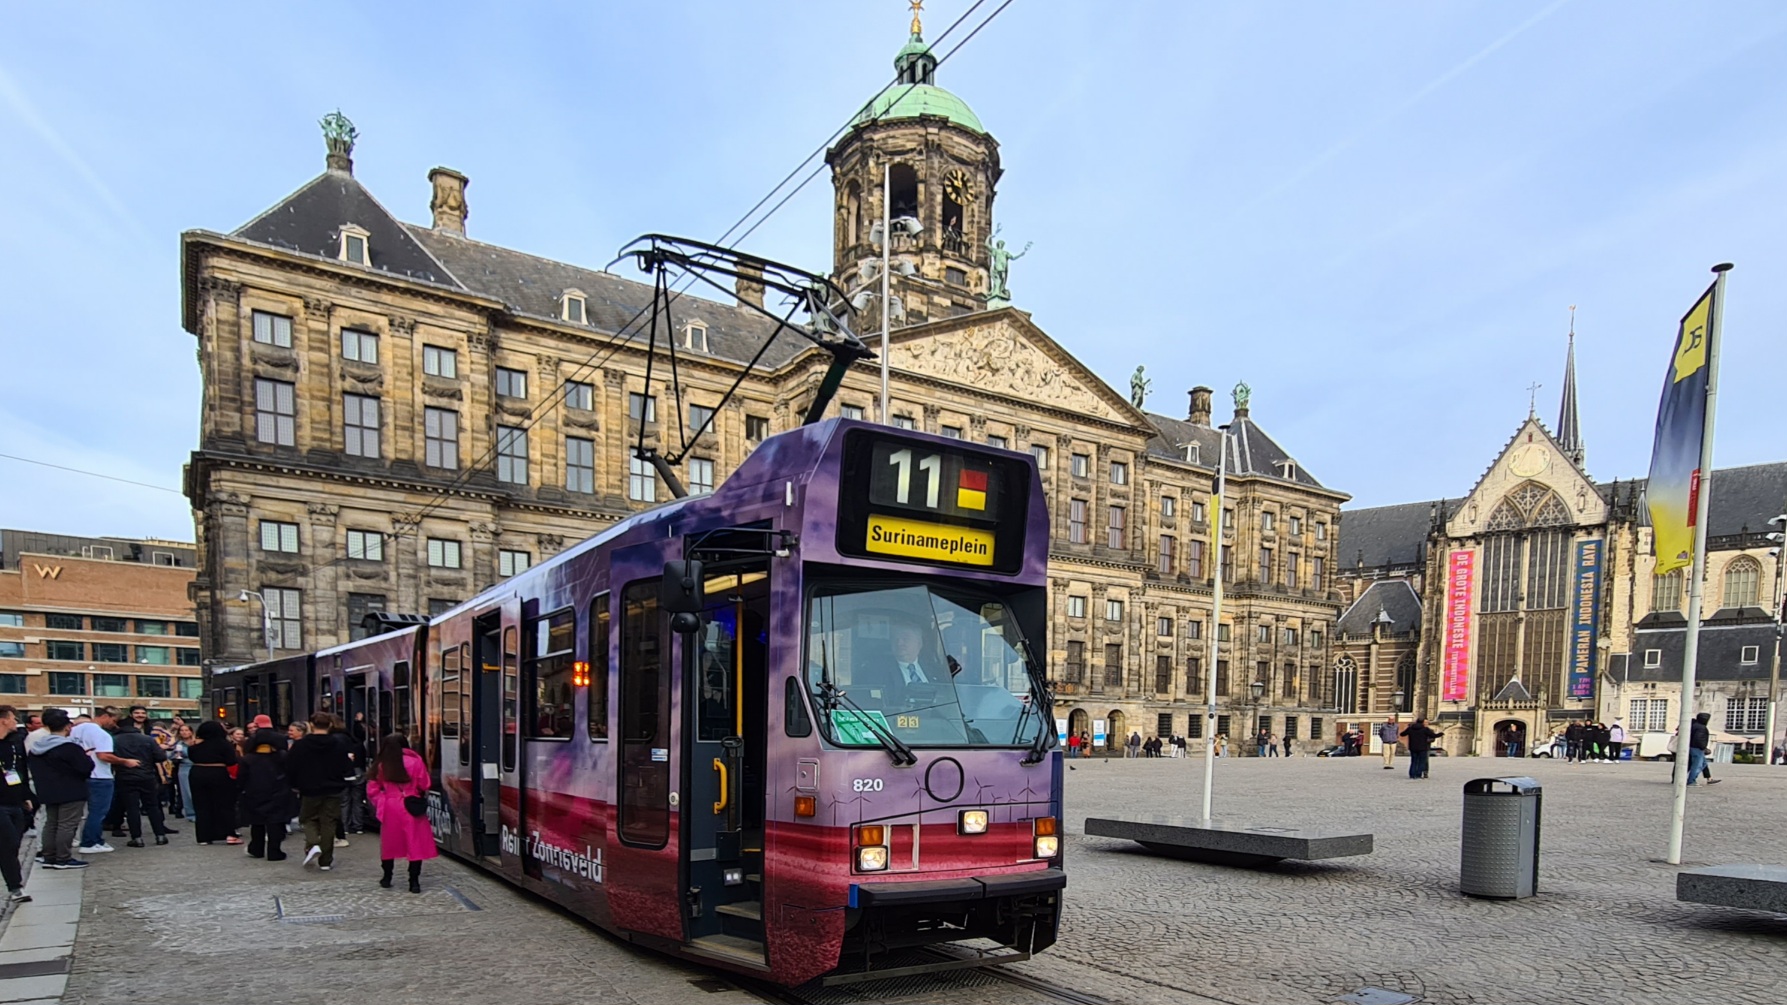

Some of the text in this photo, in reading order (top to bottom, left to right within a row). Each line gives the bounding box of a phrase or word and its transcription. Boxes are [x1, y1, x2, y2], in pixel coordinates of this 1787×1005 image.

[889, 449, 941, 508] 11
[871, 524, 988, 556] Surinameplein
[34, 563, 62, 579] W
[1452, 554, 1469, 649] DE GROTE INDONESIE
[1576, 543, 1596, 674] PAMERAN INDONESIA RAYA
[853, 778, 884, 792] 820
[532, 830, 603, 884] Zonneveld
